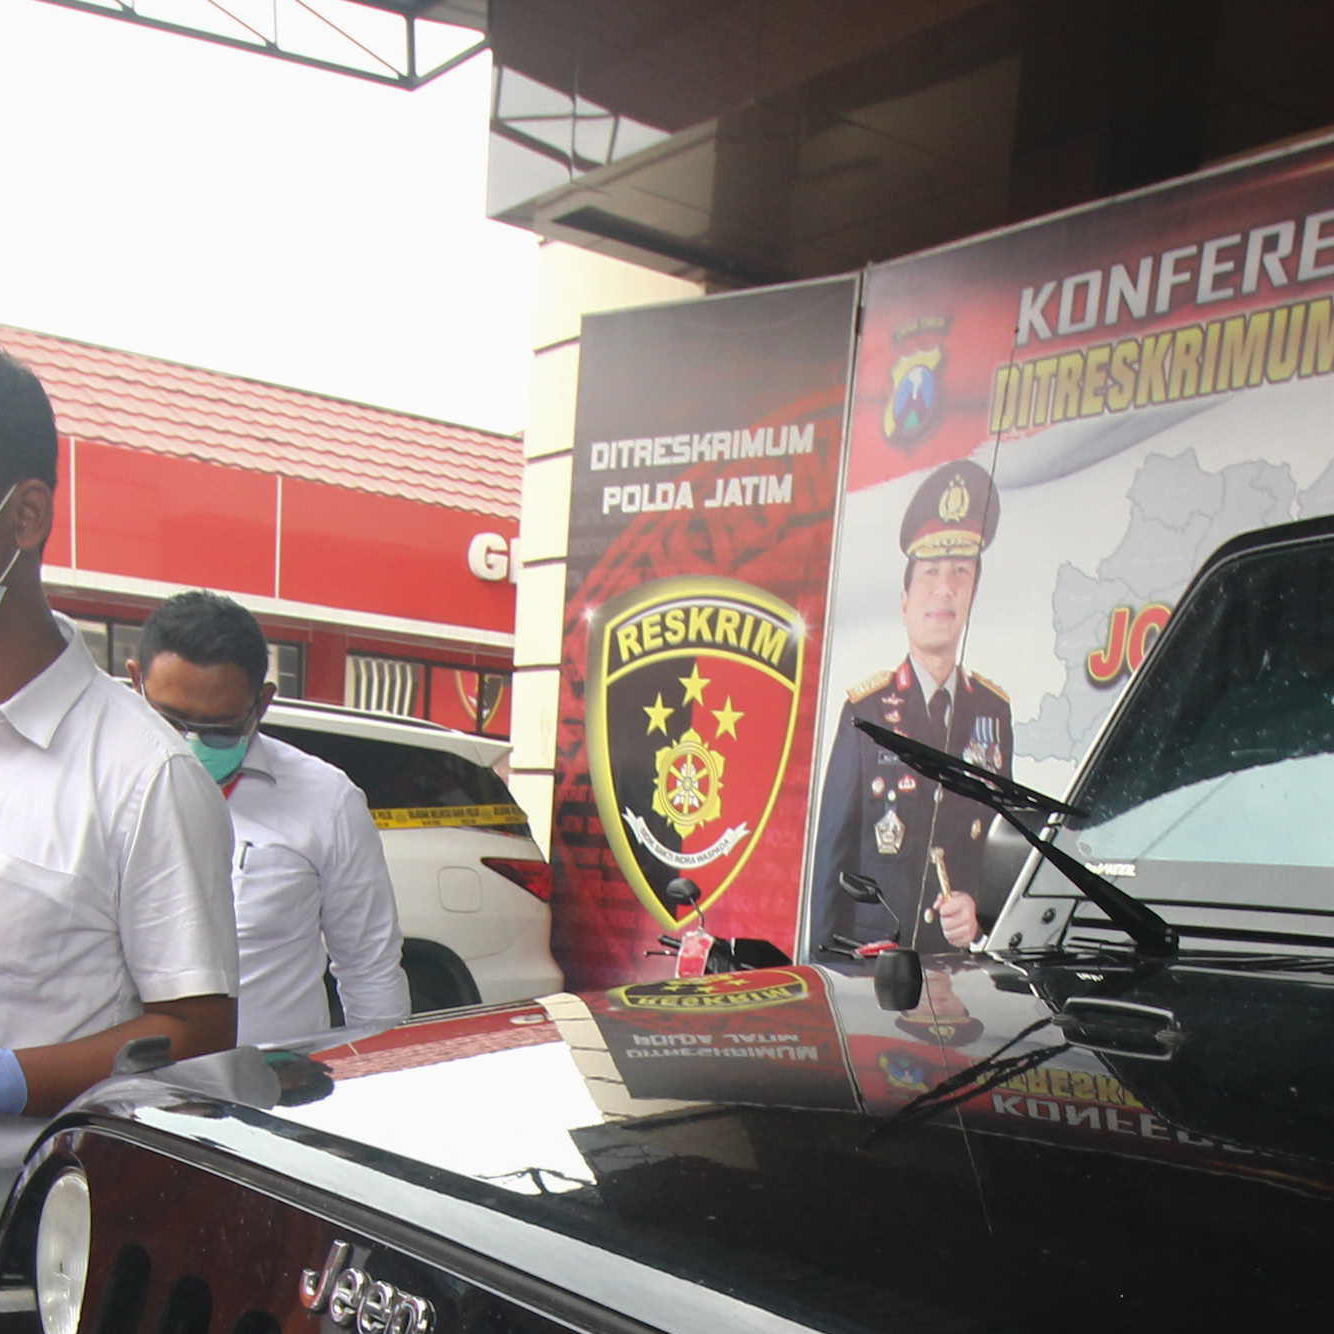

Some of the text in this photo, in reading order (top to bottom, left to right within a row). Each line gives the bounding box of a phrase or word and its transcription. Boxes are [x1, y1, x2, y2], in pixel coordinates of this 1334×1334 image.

[590, 423, 815, 471] DITRESKRIMUM
[603, 474, 793, 515] POLDA JATIM
[617, 606, 789, 668] RESKRIM
